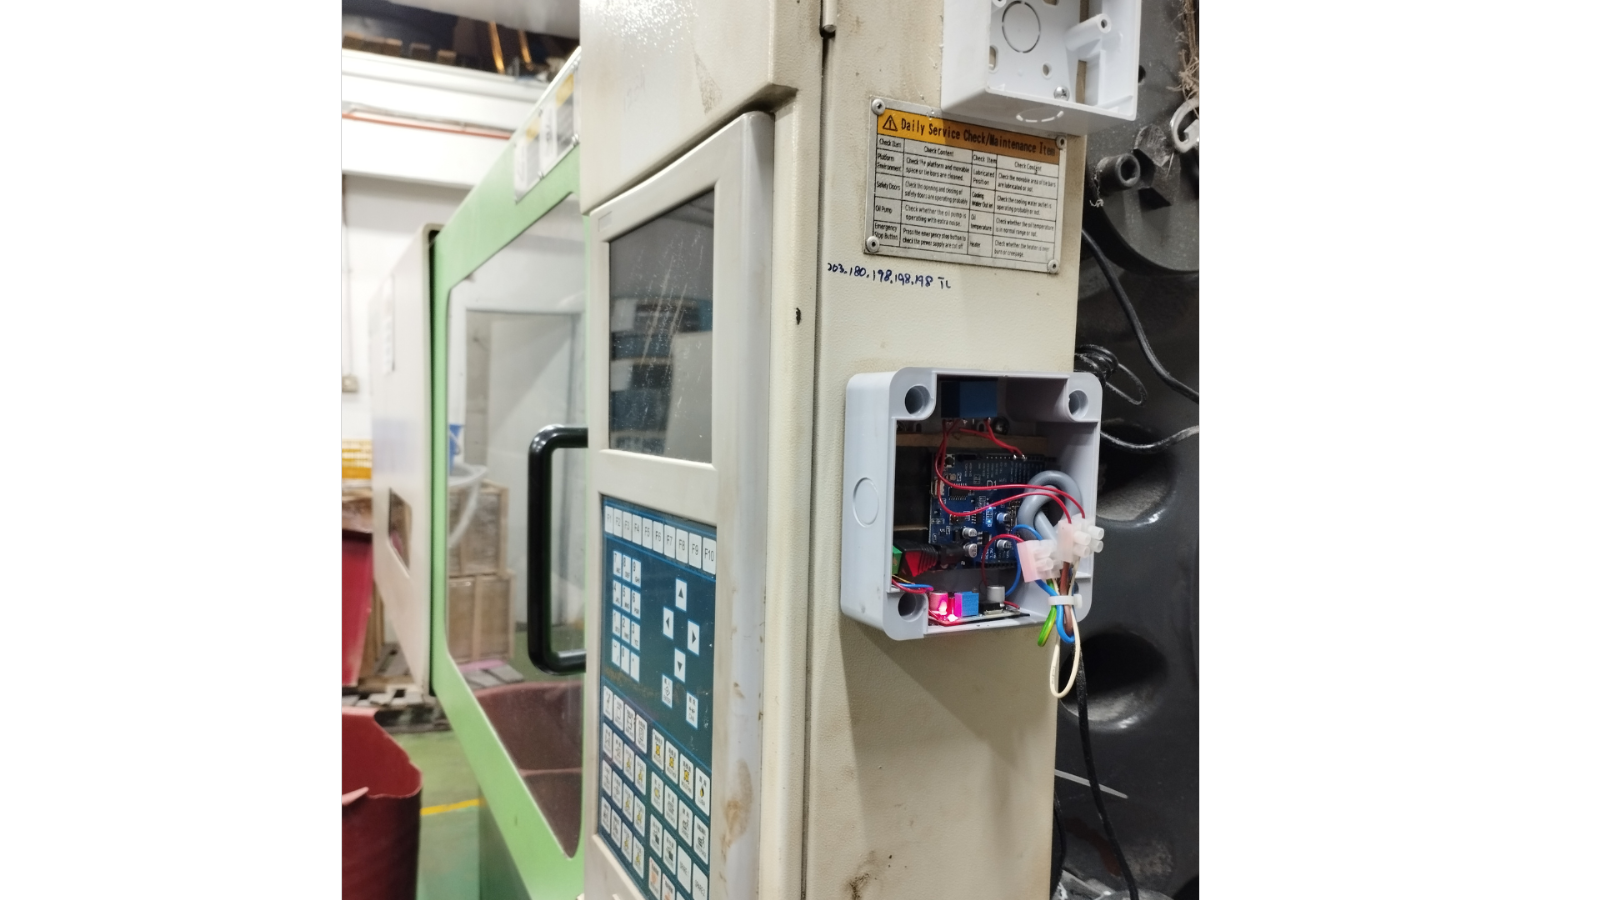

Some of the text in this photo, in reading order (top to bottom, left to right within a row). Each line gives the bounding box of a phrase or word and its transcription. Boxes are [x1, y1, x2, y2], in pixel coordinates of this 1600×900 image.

[901, 118, 1055, 156] Daily Service Check/Maintenance Item
[937, 147, 954, 157] Content
[877, 153, 894, 161] Platform
[877, 162, 901, 172] Environment
[927, 160, 944, 169] platform
[1027, 163, 1041, 172] Content
[973, 169, 994, 178] Lubricated
[876, 181, 888, 190] Safety
[923, 184, 940, 193] opening
[905, 190, 916, 198] safety
[935, 194, 952, 203] operating
[952, 197, 968, 205] probably
[919, 206, 936, 214] whether
[906, 214, 926, 223] operating
[875, 223, 897, 232] Emergency
[971, 223, 992, 231] temperature
[1032, 222, 1054, 231] temperature
[921, 231, 941, 239] emergency
[1016, 228, 1026, 237] range
[933, 240, 944, 248] supply
[634, 523, 639, 533] F4
[645, 526, 650, 537] F5
[655, 530, 661, 542] F6
[666, 534, 673, 546] F7
[679, 538, 685, 551] F8
[692, 543, 698, 555] F9
[705, 548, 714, 562] F10
